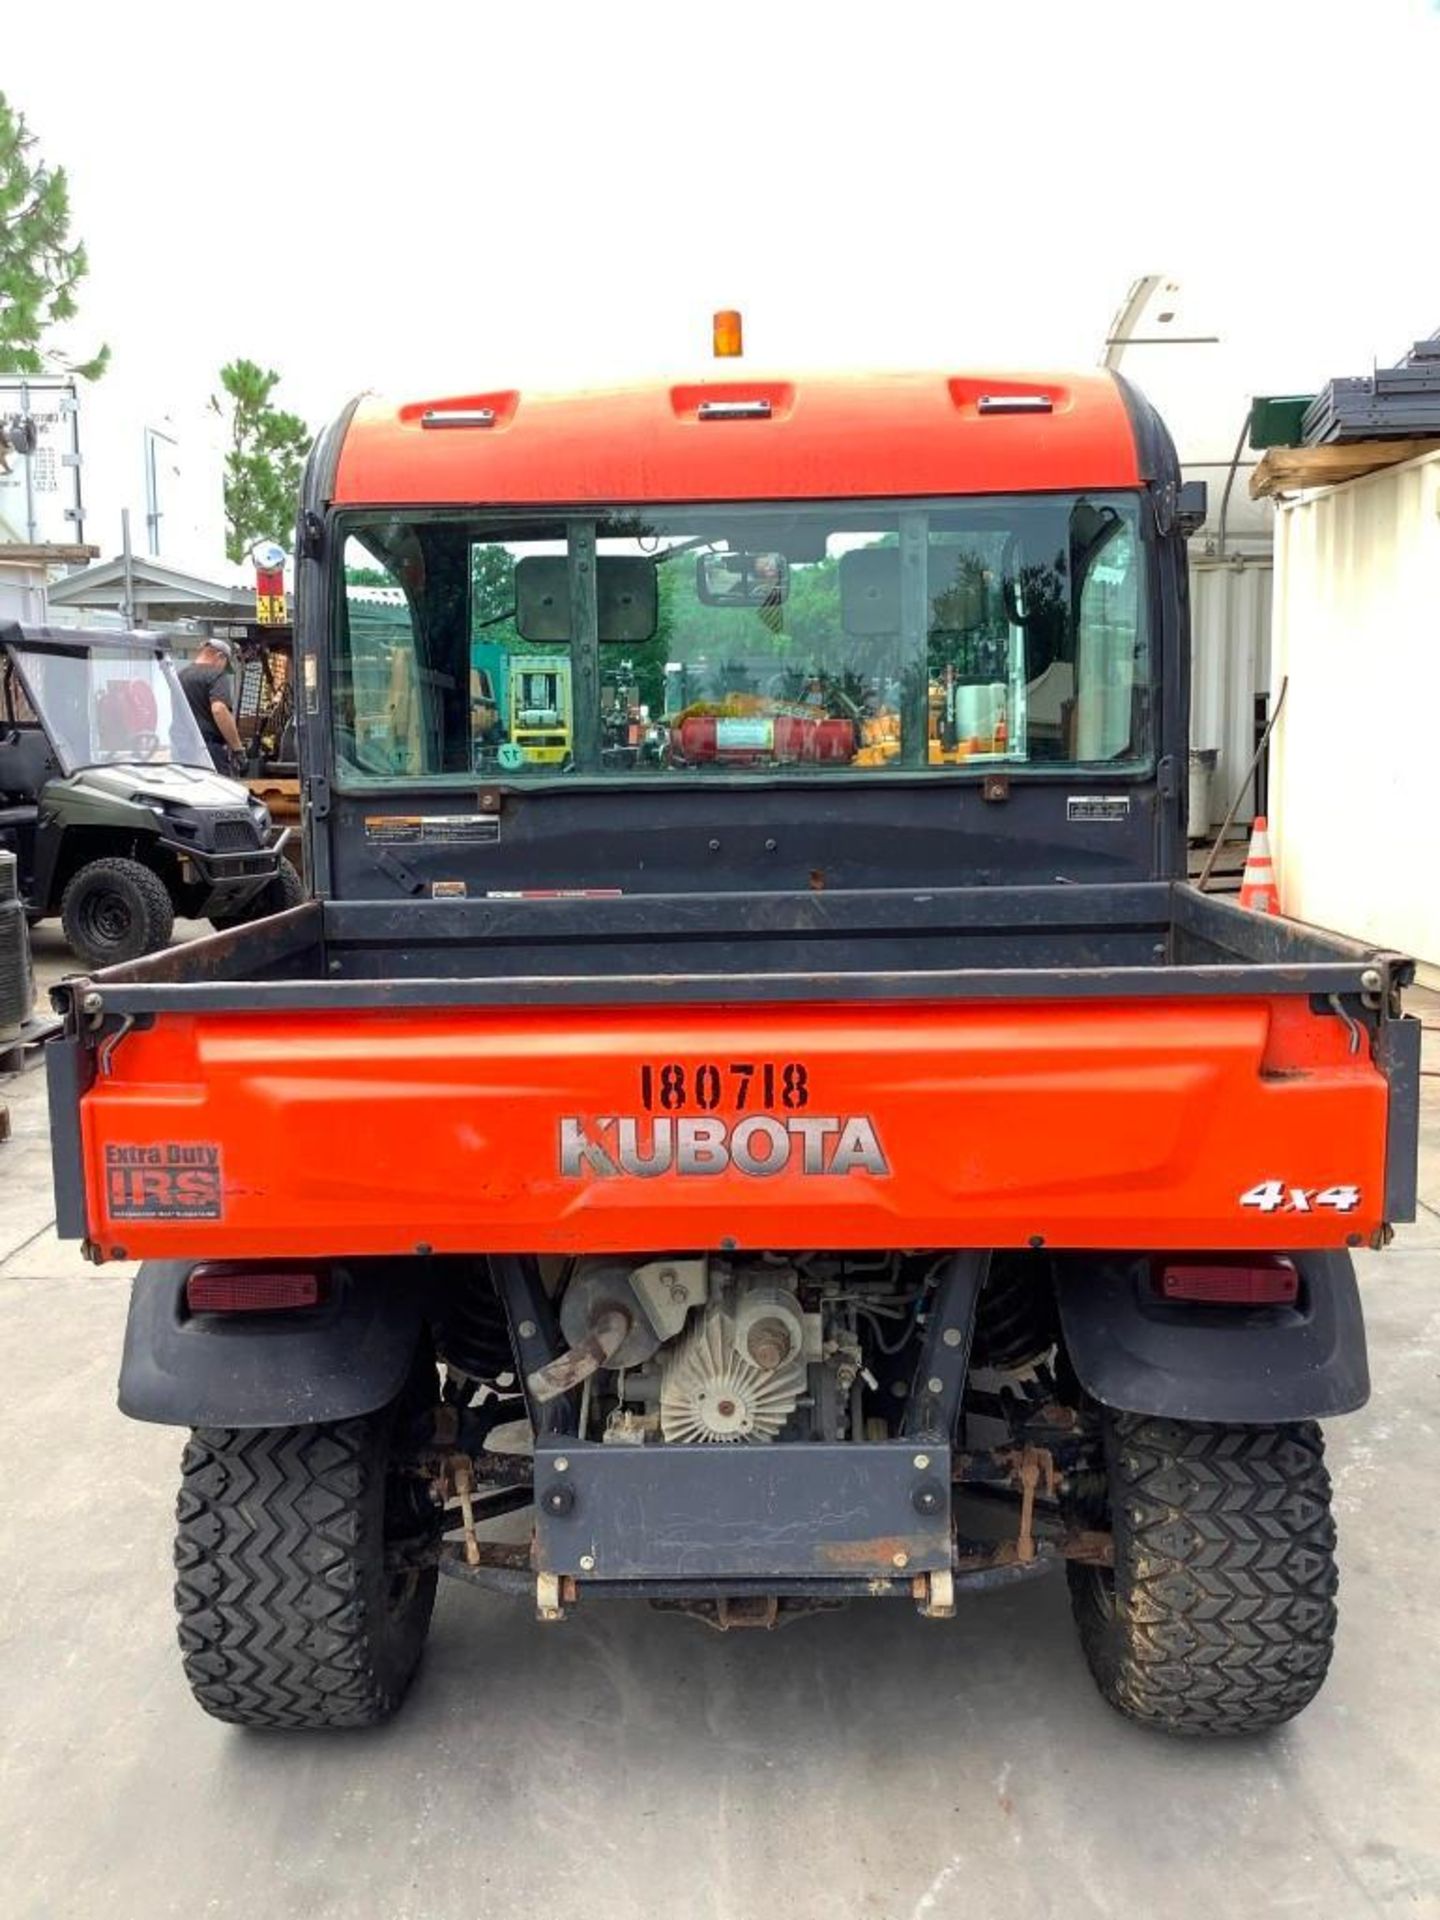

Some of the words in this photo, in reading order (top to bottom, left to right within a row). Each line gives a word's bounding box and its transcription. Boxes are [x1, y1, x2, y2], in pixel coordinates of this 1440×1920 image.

[641, 1063, 809, 1111] 180718
[106, 1145, 161, 1164] Extra
[168, 1144, 218, 1166] Duty
[560, 1115, 890, 1176] KUBOTA
[111, 1169, 216, 1206] IRS
[1239, 1179, 1361, 1213] 4x4
